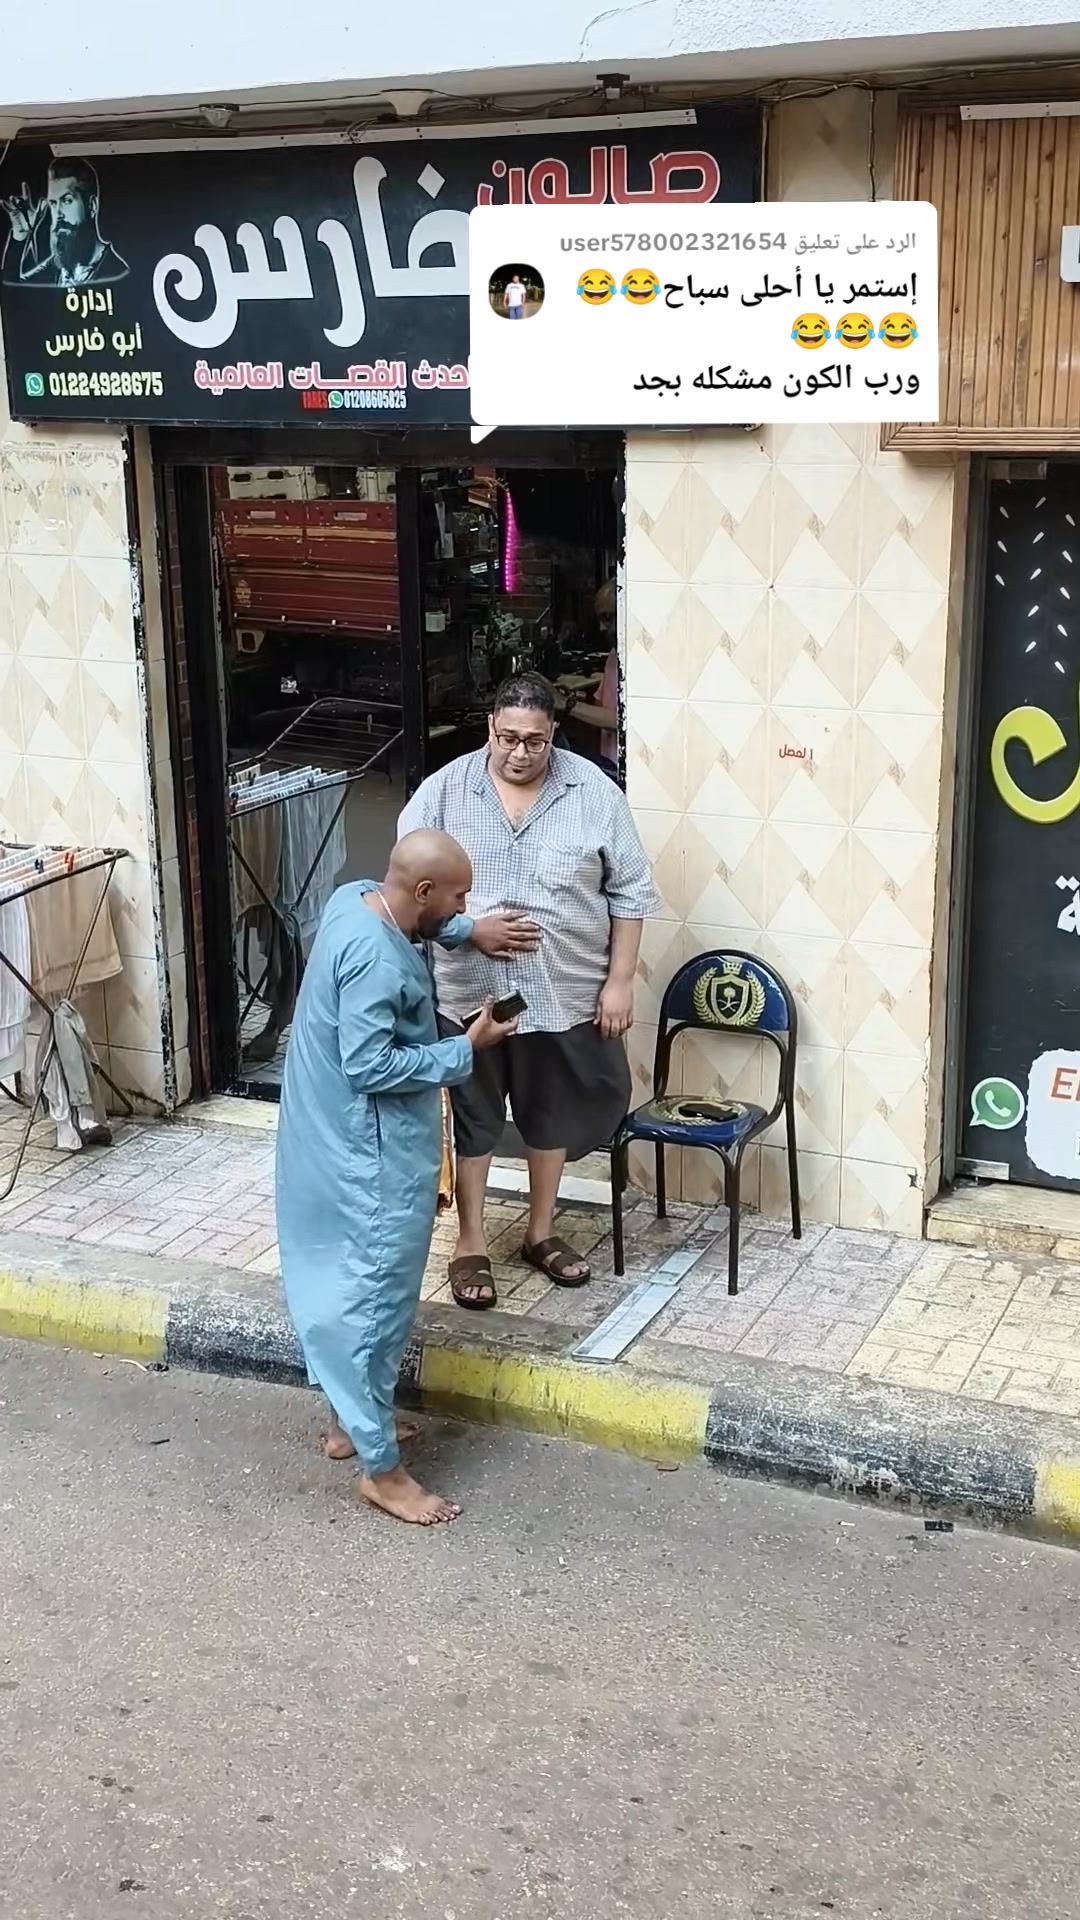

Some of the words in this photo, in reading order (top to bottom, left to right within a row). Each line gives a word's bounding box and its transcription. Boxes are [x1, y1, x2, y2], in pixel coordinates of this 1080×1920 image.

[477, 144, 721, 205] صالون
[153, 156, 471, 349] فارس
[65, 287, 114, 319] إدارة
[45, 326, 105, 358] فارس
[111, 322, 143, 358] أبو
[49, 371, 164, 396] 01224928675
[194, 360, 285, 396] العالمية
[412, 354, 471, 390] حدث
[343, 389, 407, 409] 01208605825
